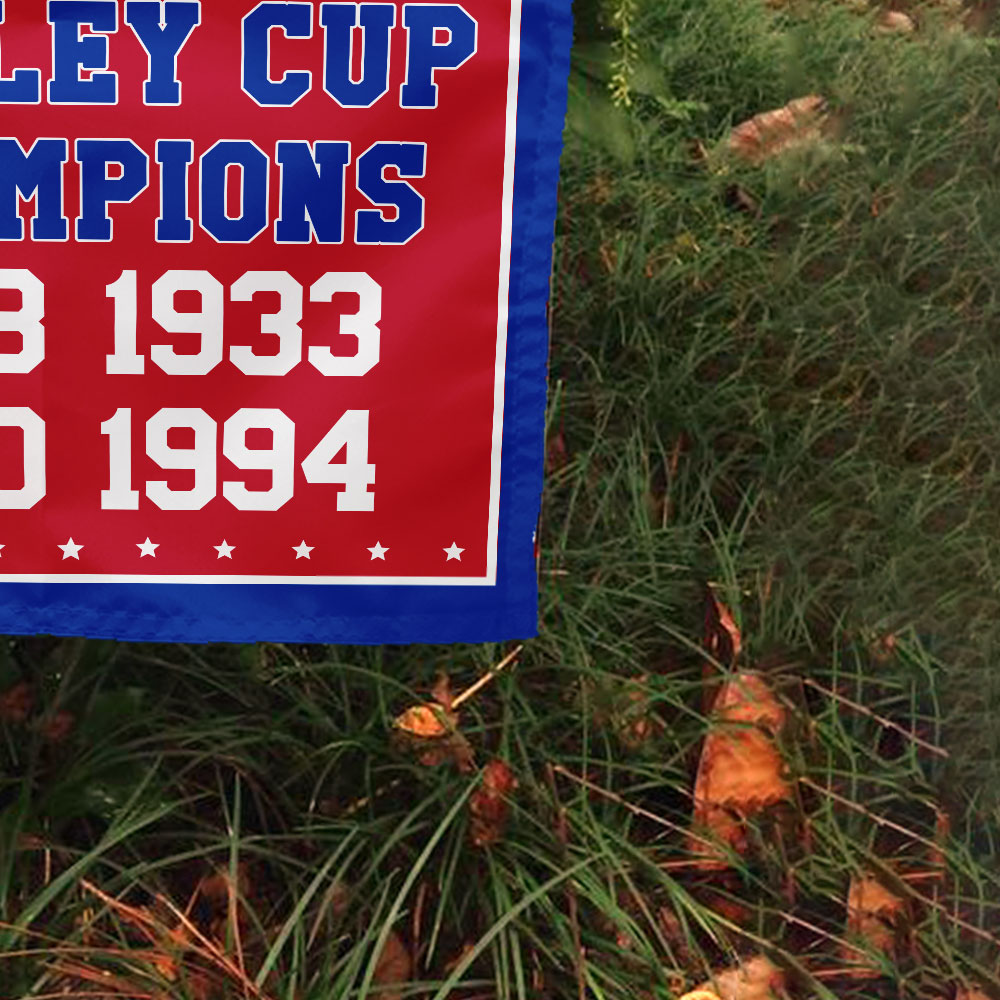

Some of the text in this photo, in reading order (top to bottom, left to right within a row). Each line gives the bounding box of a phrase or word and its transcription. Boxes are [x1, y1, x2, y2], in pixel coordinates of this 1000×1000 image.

[240, 1, 478, 109] CUP
[105, 269, 382, 376] 1933
[100, 407, 376, 512] 1994
